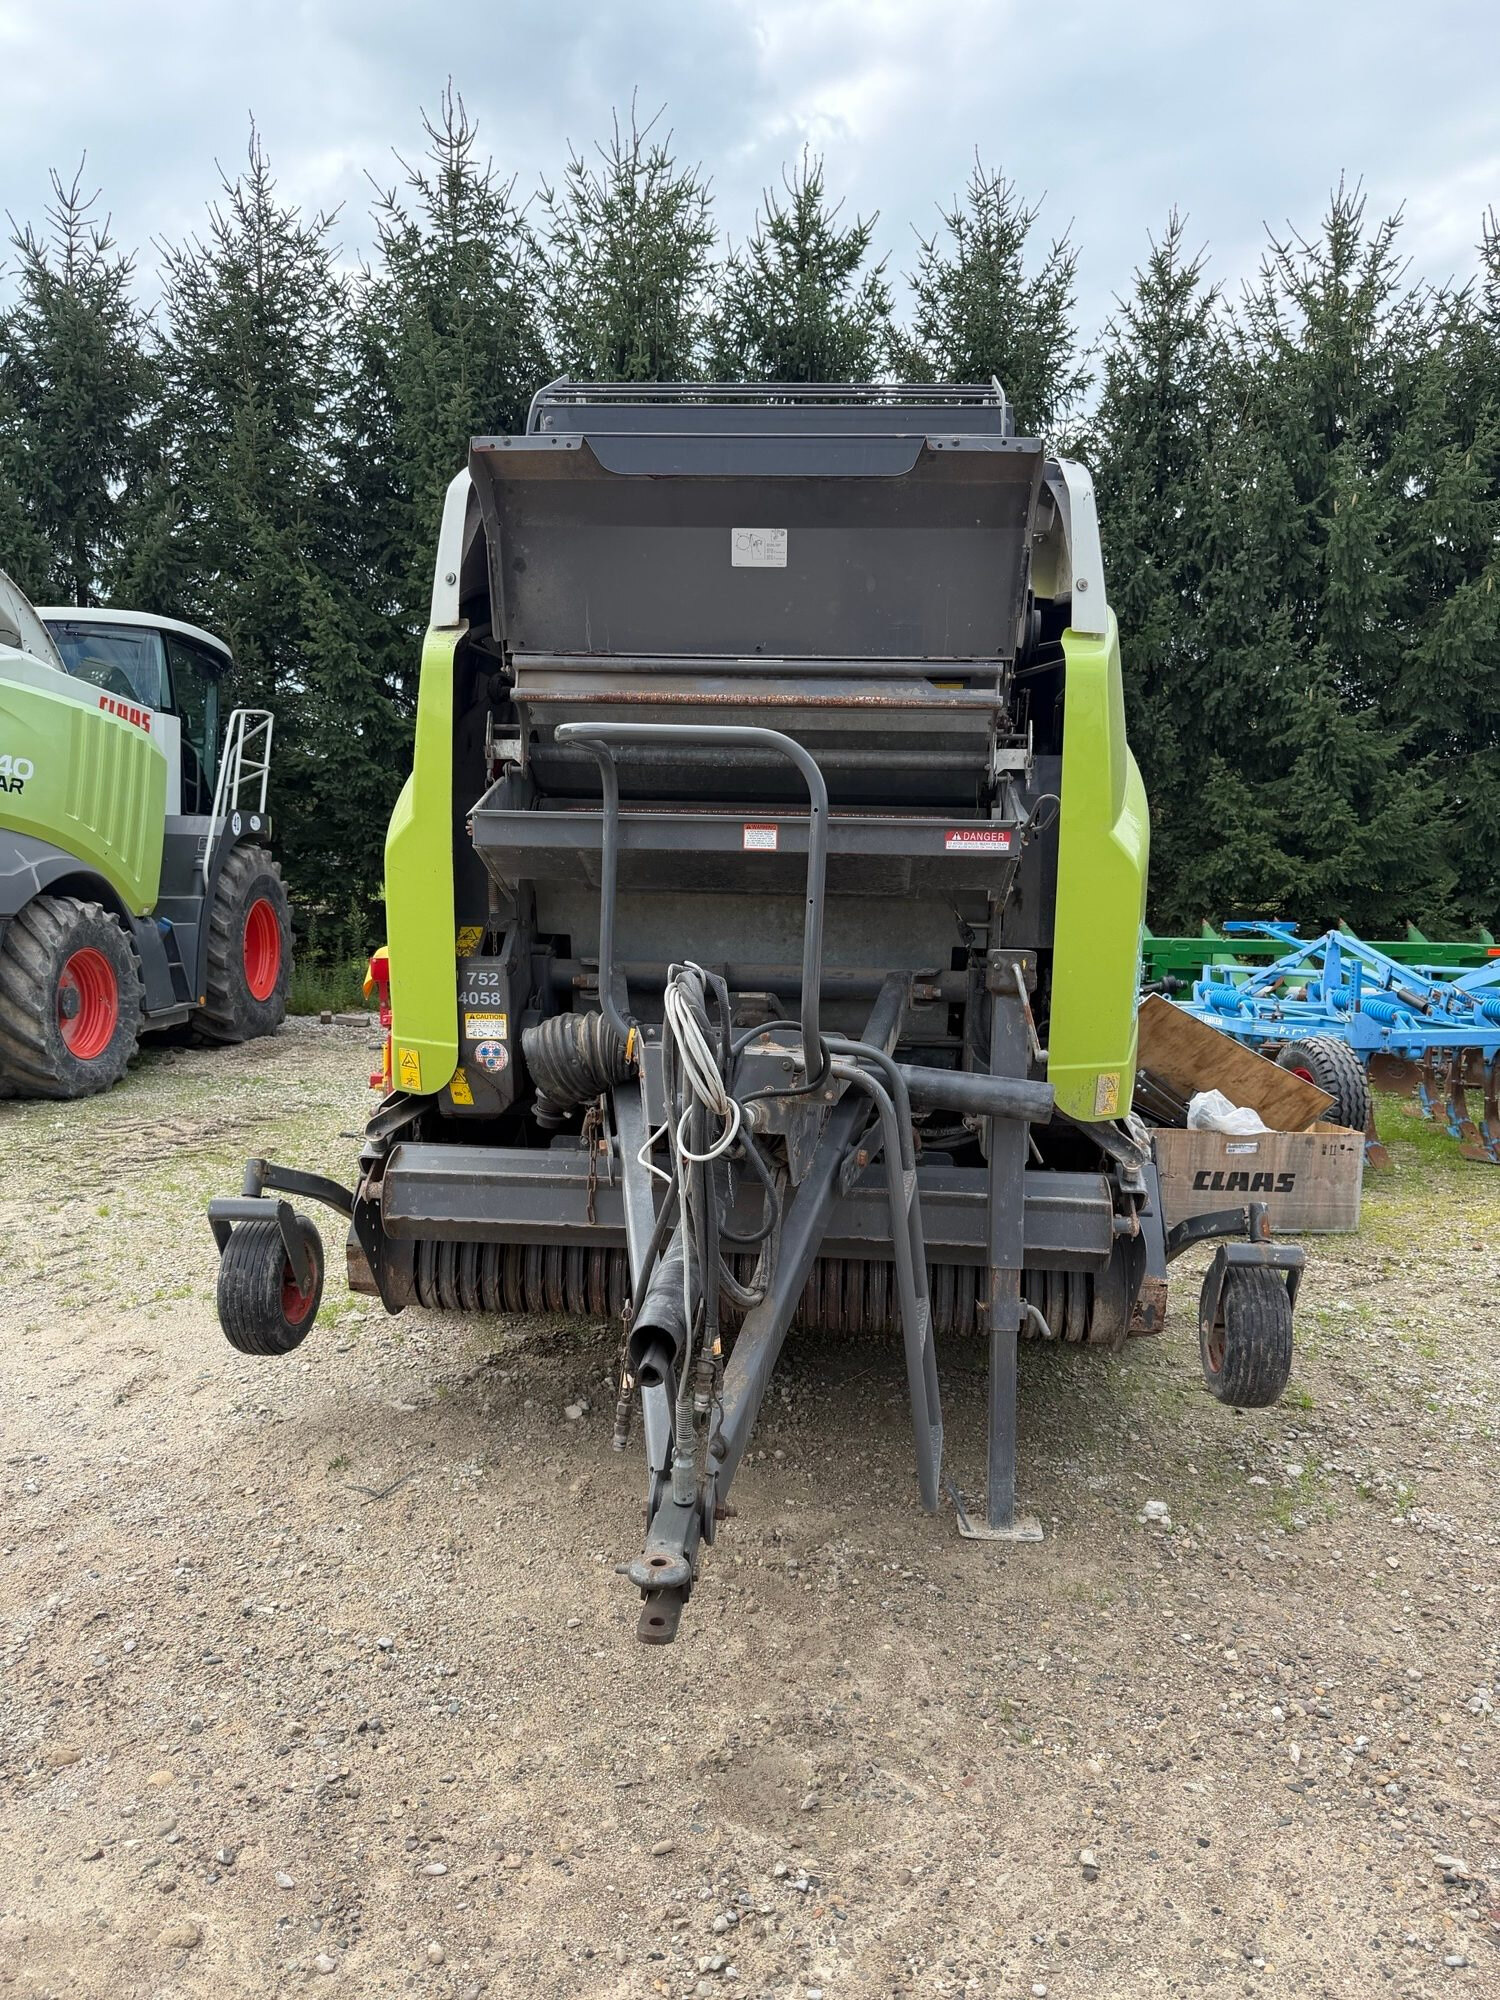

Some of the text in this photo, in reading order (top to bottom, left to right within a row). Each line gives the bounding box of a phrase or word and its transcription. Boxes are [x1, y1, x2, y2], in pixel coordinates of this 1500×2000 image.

[963, 831, 1005, 841] DANGER
[466, 972, 499, 986] 752
[458, 991, 501, 1005] 4058
[1192, 1171, 1296, 1192] CLAAS
